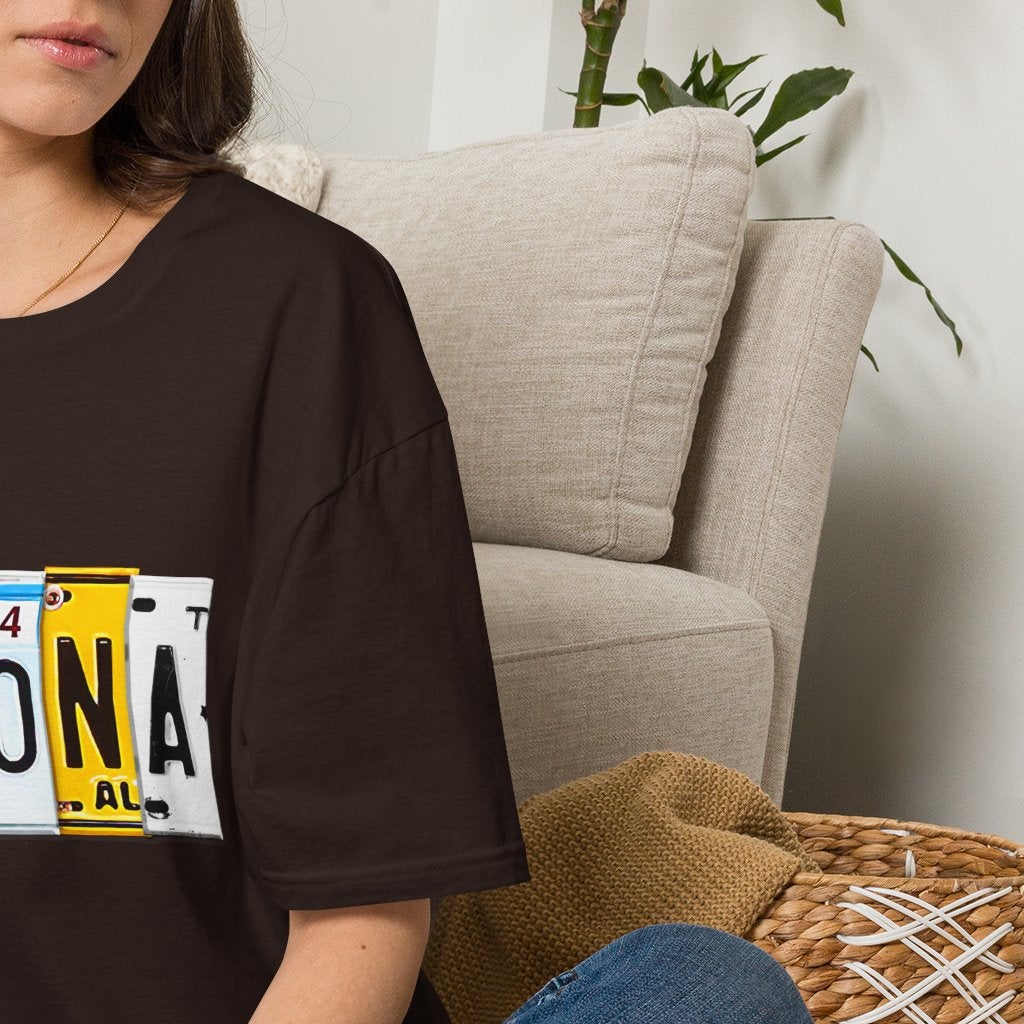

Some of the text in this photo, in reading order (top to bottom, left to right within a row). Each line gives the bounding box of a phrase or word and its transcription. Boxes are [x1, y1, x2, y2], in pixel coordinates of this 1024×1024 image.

[0, 606, 21, 637] 4
[185, 606, 208, 631] T
[96, 781, 140, 811] AL
